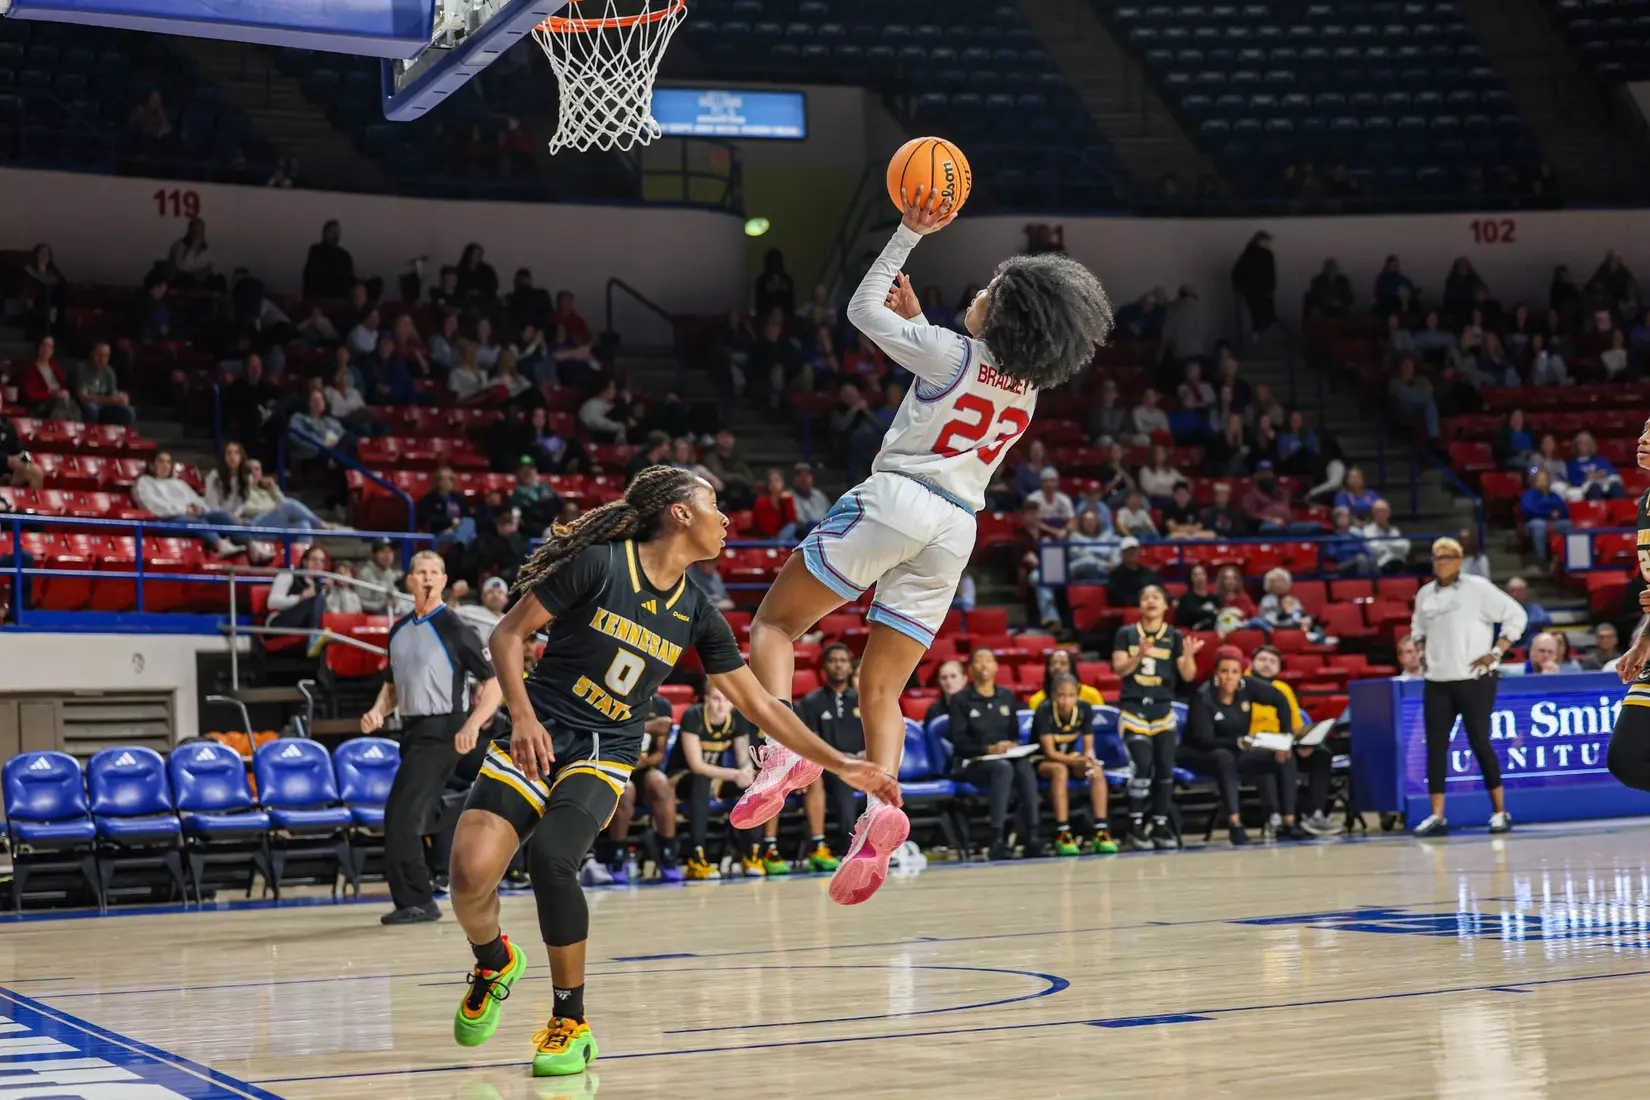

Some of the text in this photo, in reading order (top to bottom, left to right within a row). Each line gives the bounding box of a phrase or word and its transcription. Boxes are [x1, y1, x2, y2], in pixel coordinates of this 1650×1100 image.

[152, 188, 201, 219] 119
[1469, 217, 1517, 245] 102
[930, 392, 1030, 466] 23
[589, 606, 683, 667] KENNESAW
[604, 646, 646, 697] 0
[1140, 656, 1157, 676] 3
[1530, 695, 1623, 738] Smit
